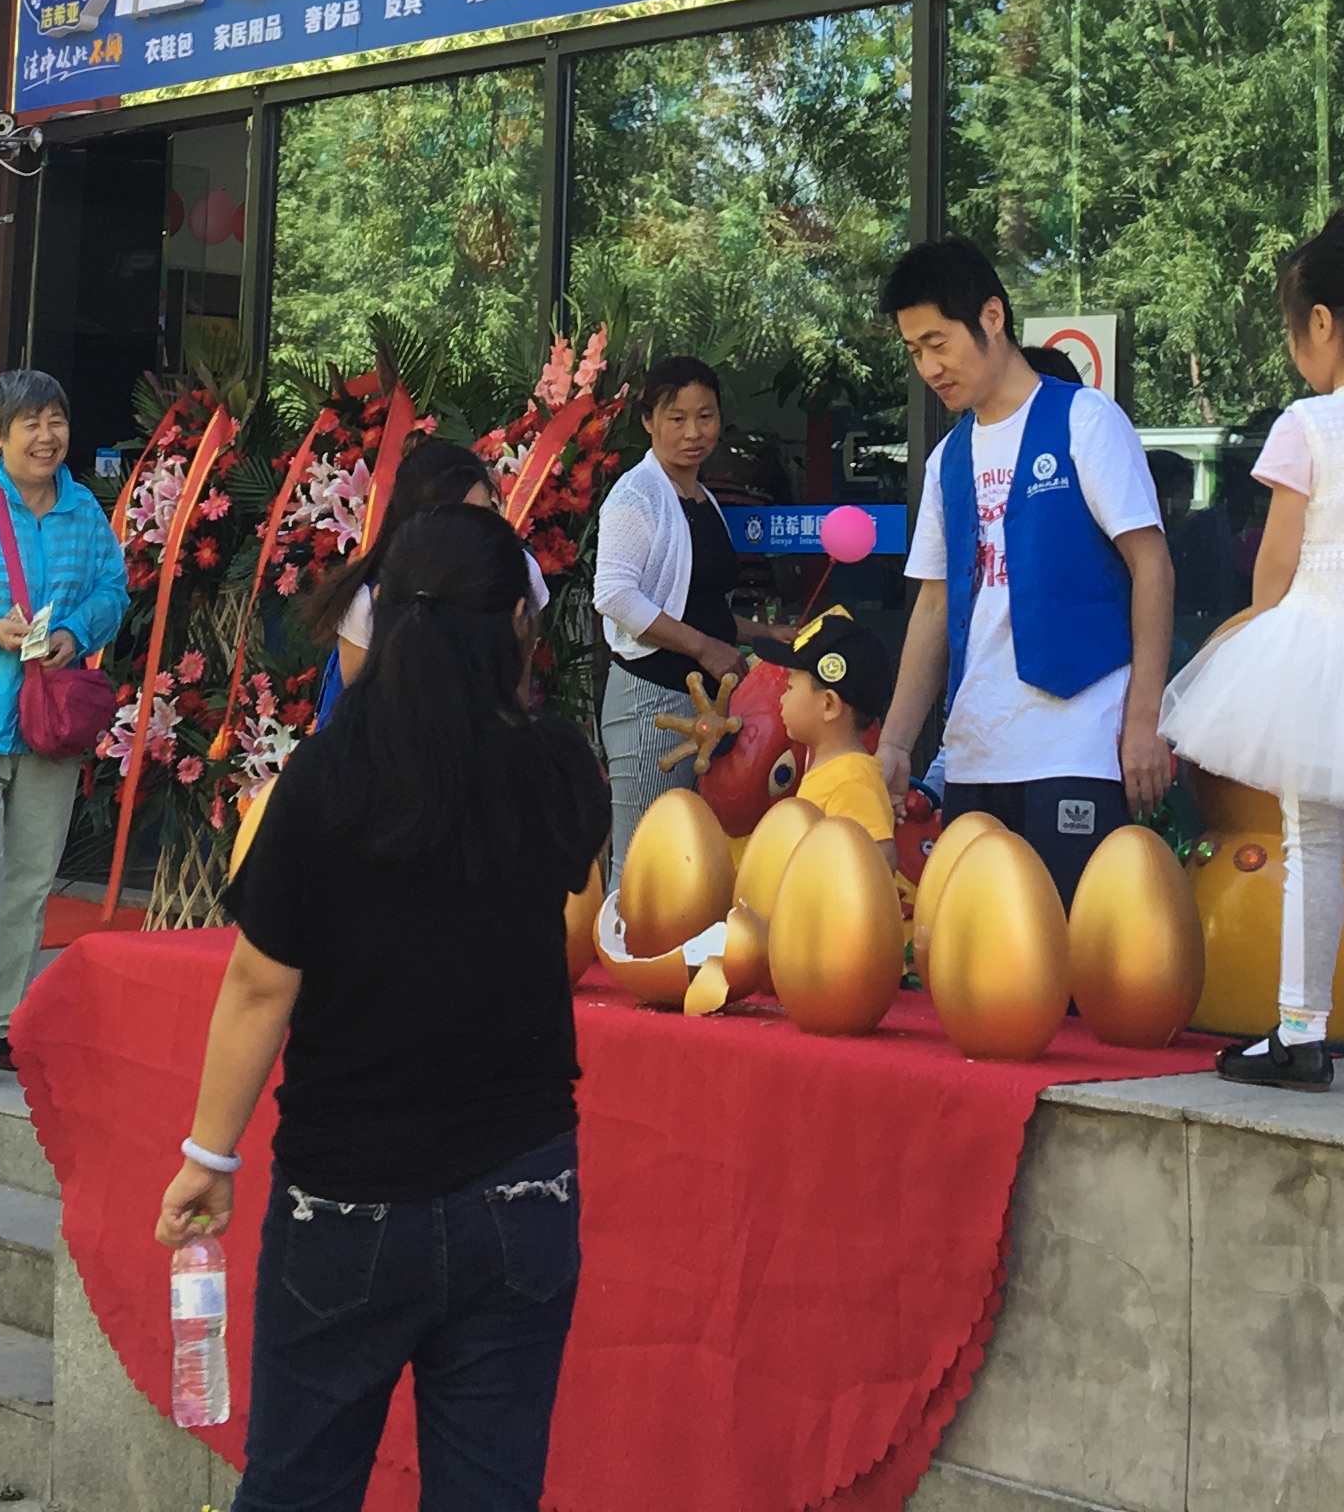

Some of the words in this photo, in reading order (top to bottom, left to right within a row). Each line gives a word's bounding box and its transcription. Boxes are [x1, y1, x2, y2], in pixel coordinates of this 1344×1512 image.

[40, 0, 81, 29] 洁希亚
[144, 32, 194, 64] 衣鞋包
[213, 13, 283, 52] 家居用品
